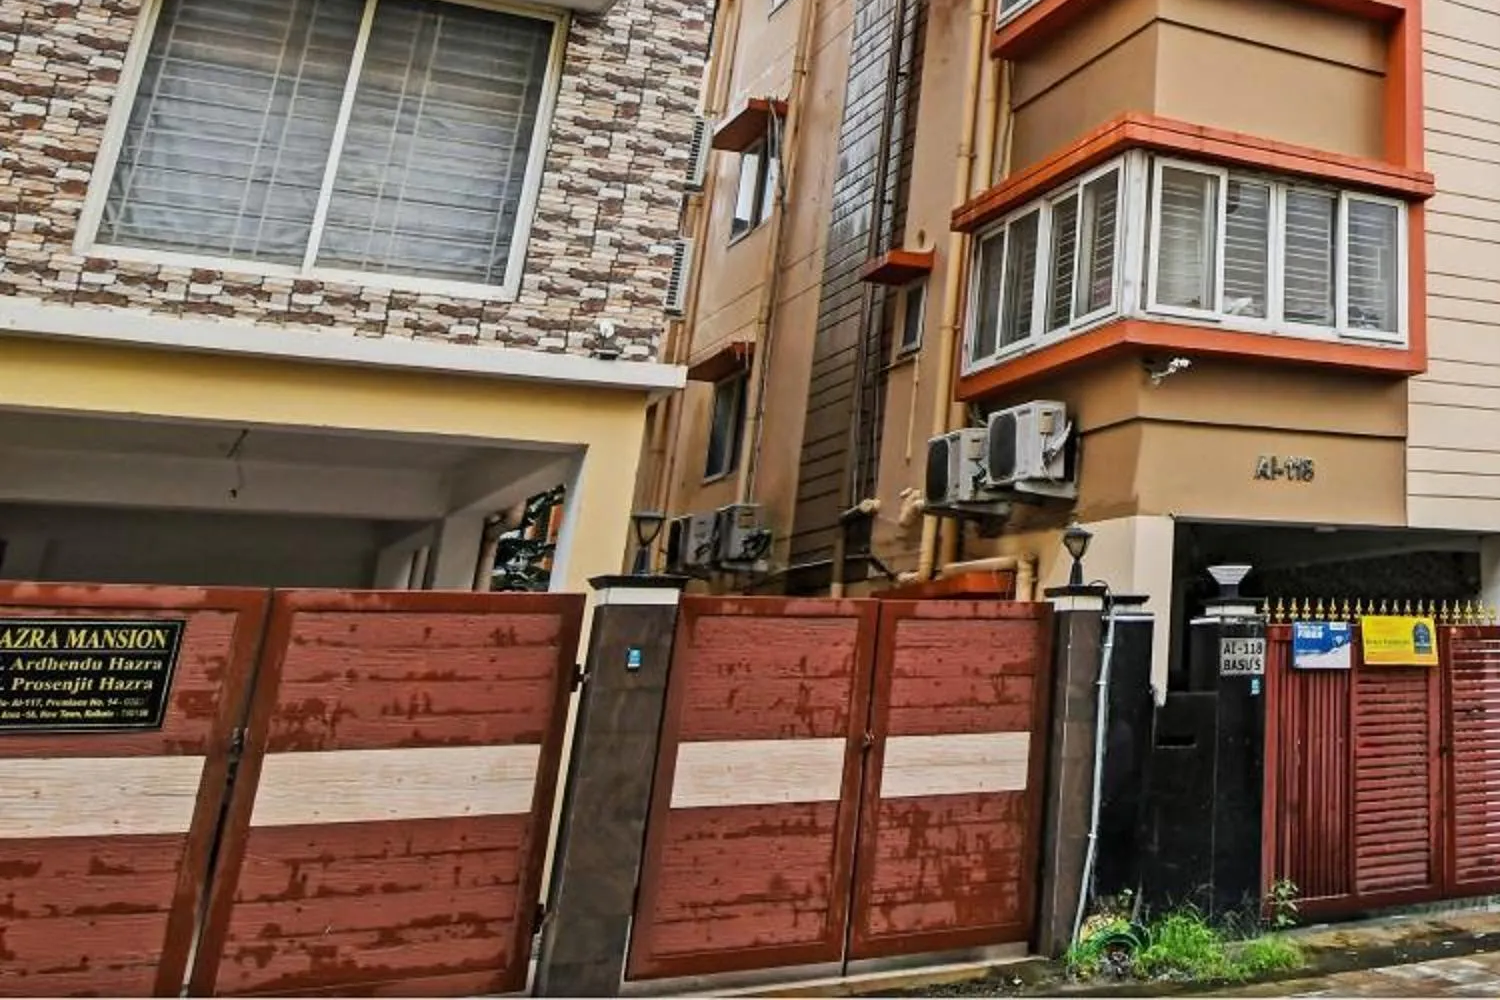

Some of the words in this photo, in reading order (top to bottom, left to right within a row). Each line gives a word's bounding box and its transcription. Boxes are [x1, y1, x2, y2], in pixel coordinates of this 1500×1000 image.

[64, 628, 170, 649] MANSION
[9, 656, 103, 671] Ardhendu
[108, 657, 163, 671] Hazra
[11, 677, 93, 694] Prosenjit
[99, 677, 153, 691] Hazra
